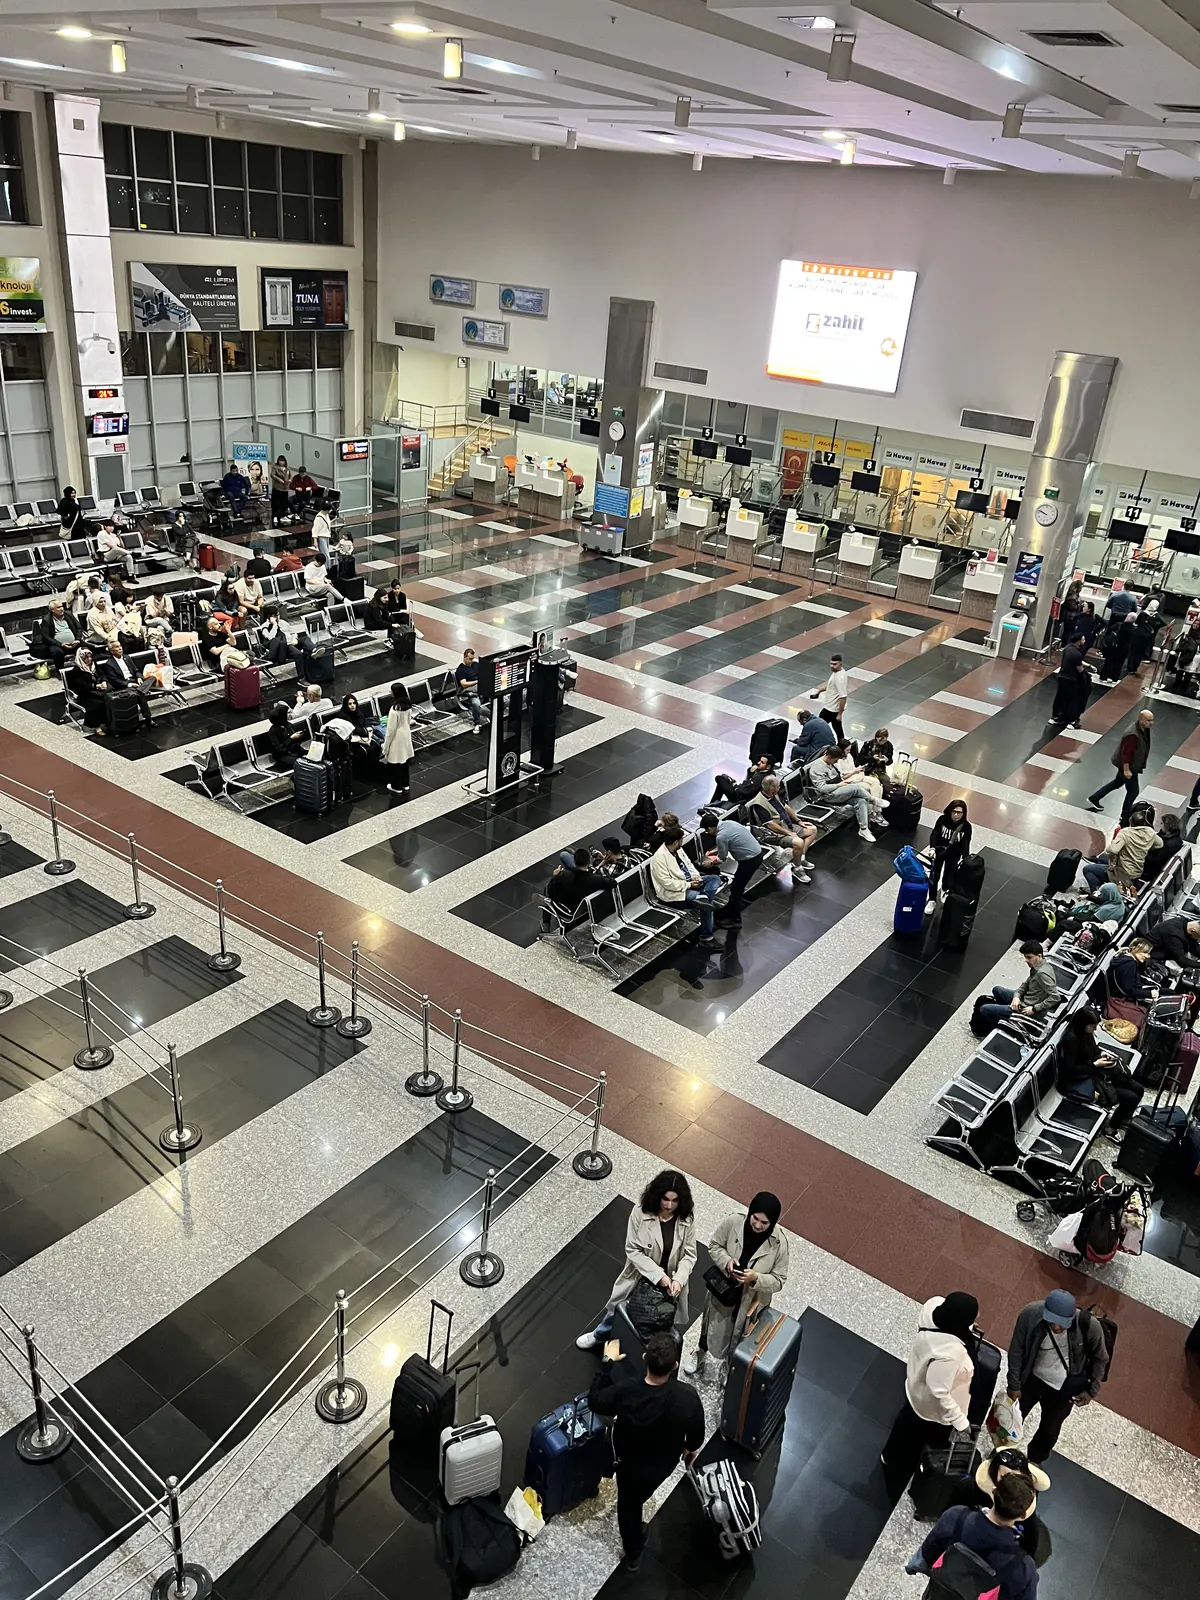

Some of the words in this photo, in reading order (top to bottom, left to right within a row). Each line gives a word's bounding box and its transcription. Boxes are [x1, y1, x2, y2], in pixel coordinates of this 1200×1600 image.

[296, 294, 319, 304] TUNA
[823, 314, 865, 331] zahit
[590, 408, 595, 416] 3
[738, 435, 744, 443] 6
[827, 453, 833, 461] 7
[893, 452, 912, 462] Havaş
[866, 461, 872, 469] 8
[926, 458, 947, 468] Havaş
[1004, 472, 1026, 481] Havaş
[973, 479, 980, 488] 9
[1169, 500, 1194, 510] Havaş
[1127, 508, 1140, 518] 11
[1182, 519, 1195, 528] 12
